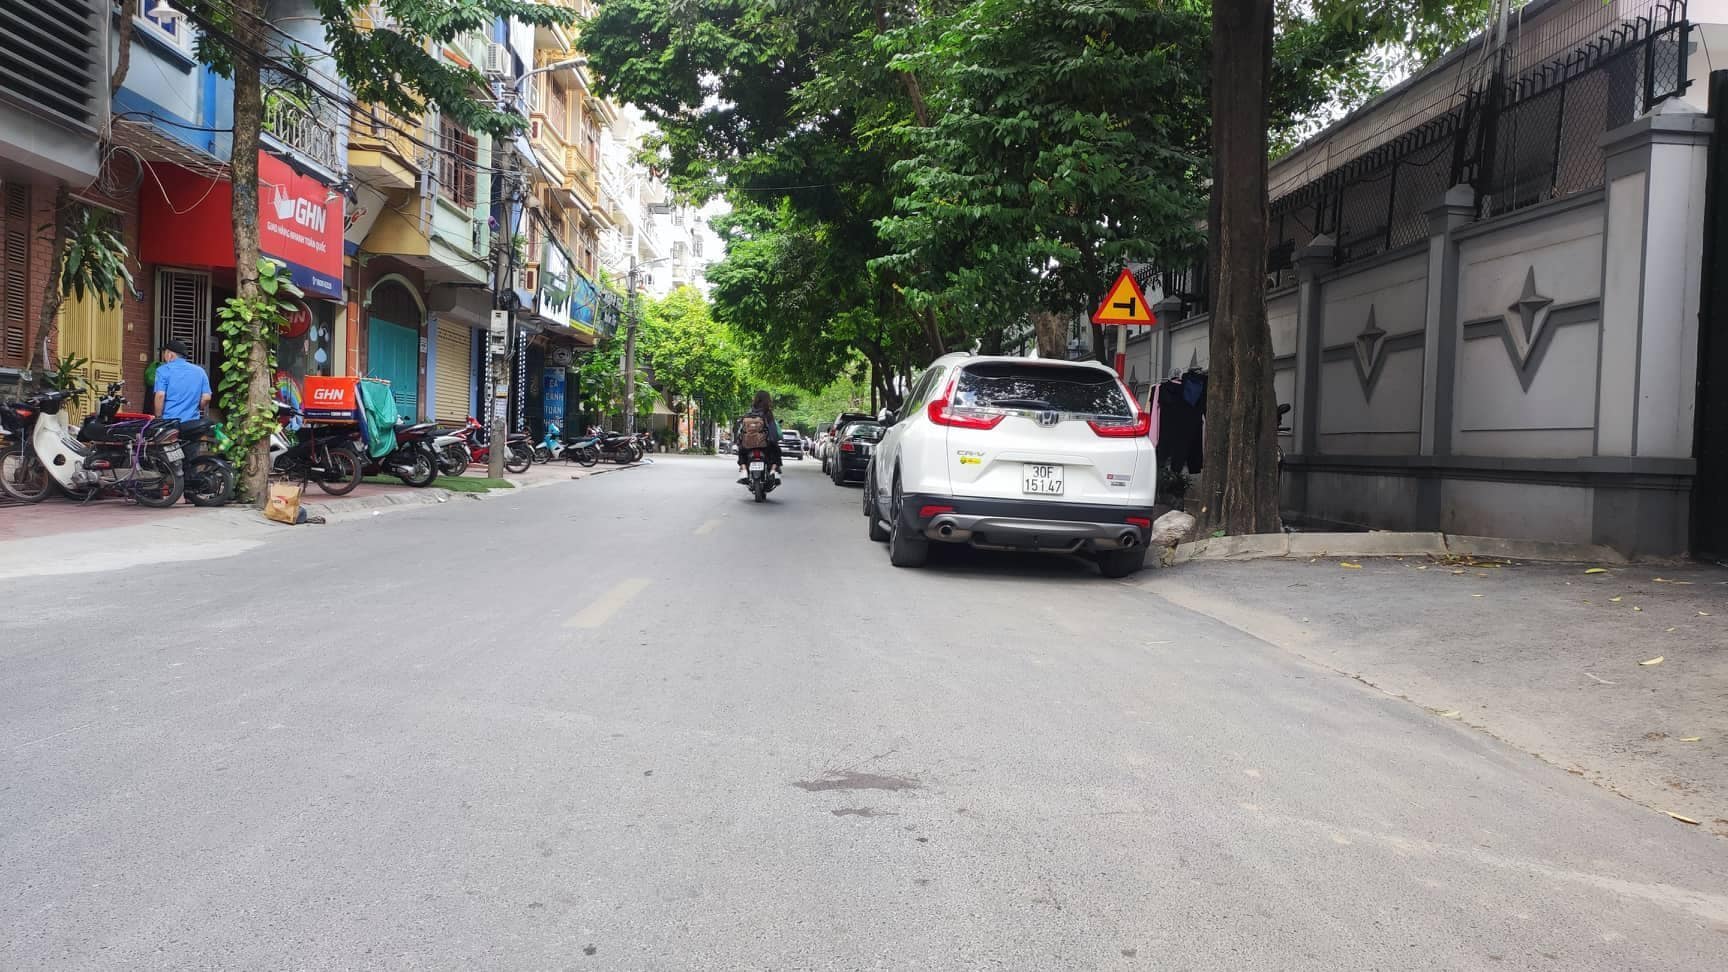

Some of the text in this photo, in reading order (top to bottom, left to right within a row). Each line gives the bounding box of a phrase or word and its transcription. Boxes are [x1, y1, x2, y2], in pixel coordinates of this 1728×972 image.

[296, 198, 327, 233] GHN
[313, 388, 345, 400] GHN
[1033, 466, 1053, 478] 30F
[1025, 480, 1062, 493] 151.47
